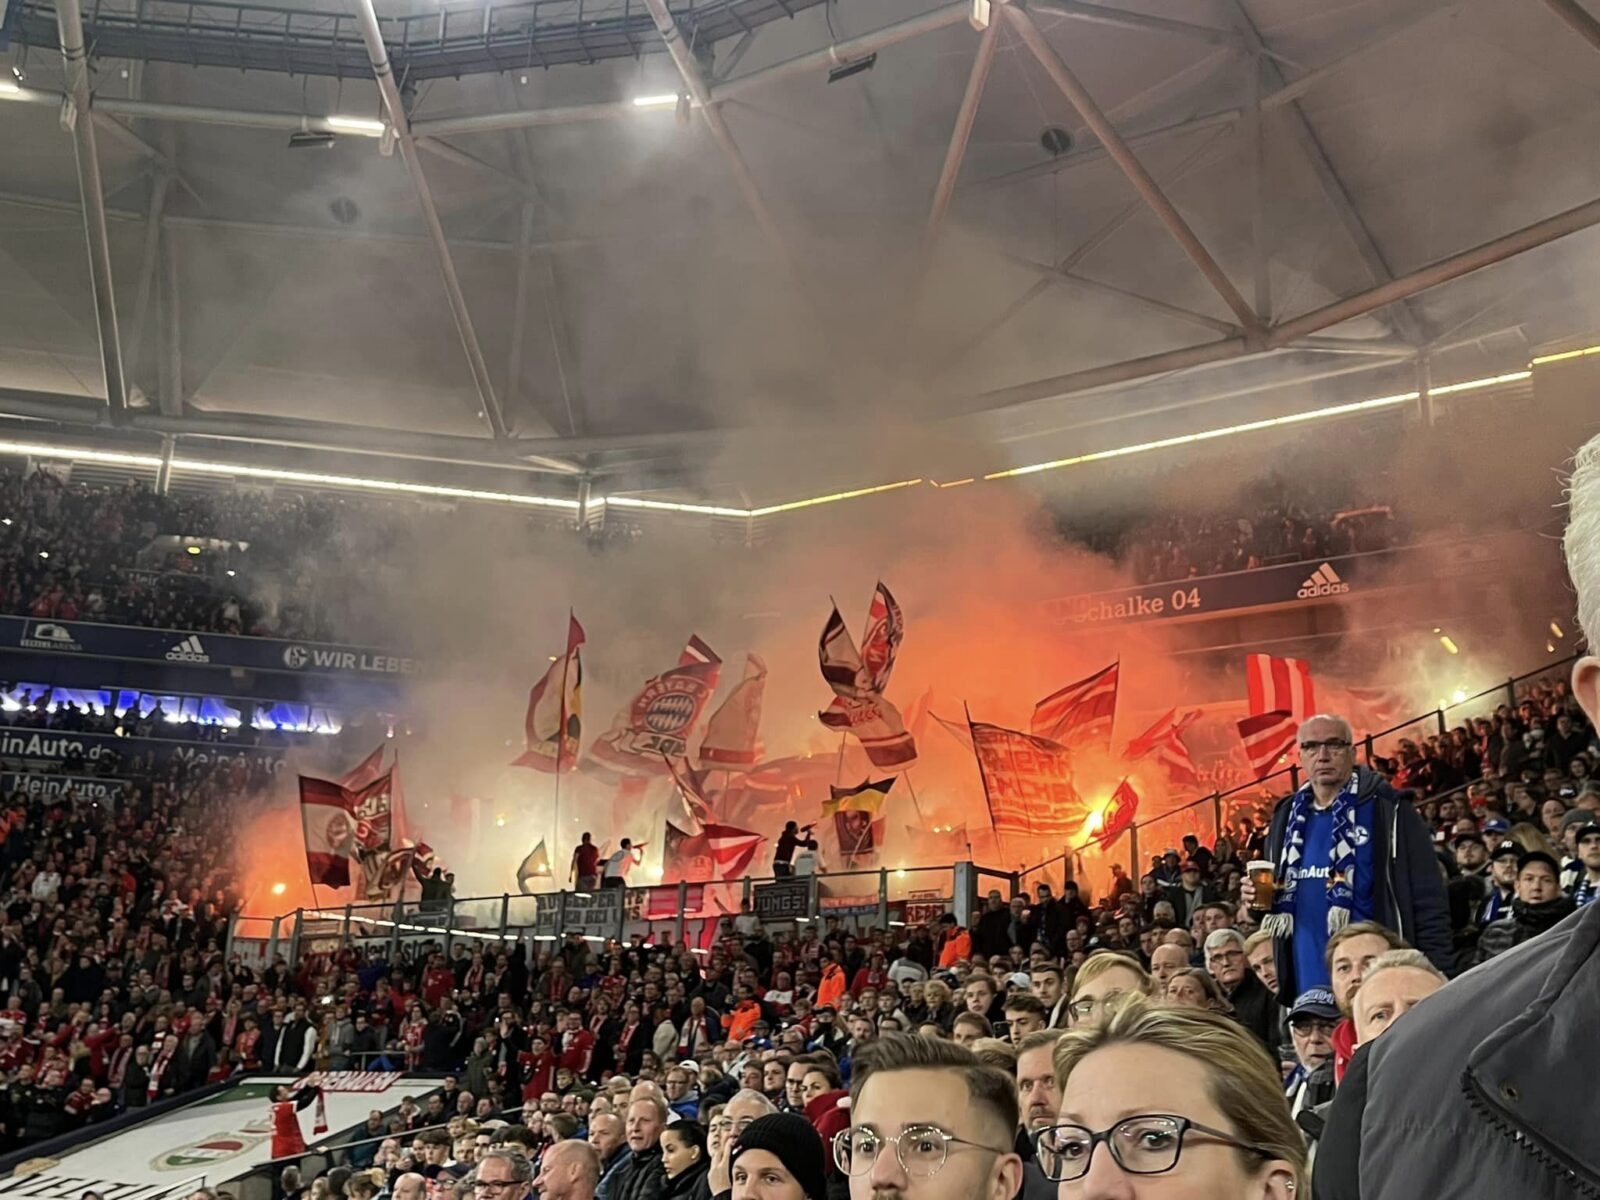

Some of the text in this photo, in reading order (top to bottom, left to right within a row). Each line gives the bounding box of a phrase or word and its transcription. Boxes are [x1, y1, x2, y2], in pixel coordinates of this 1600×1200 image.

[1171, 587, 1201, 611] 04
[1297, 582, 1350, 599] adidas
[165, 650, 210, 663] adidas
[313, 650, 357, 669] WIR
